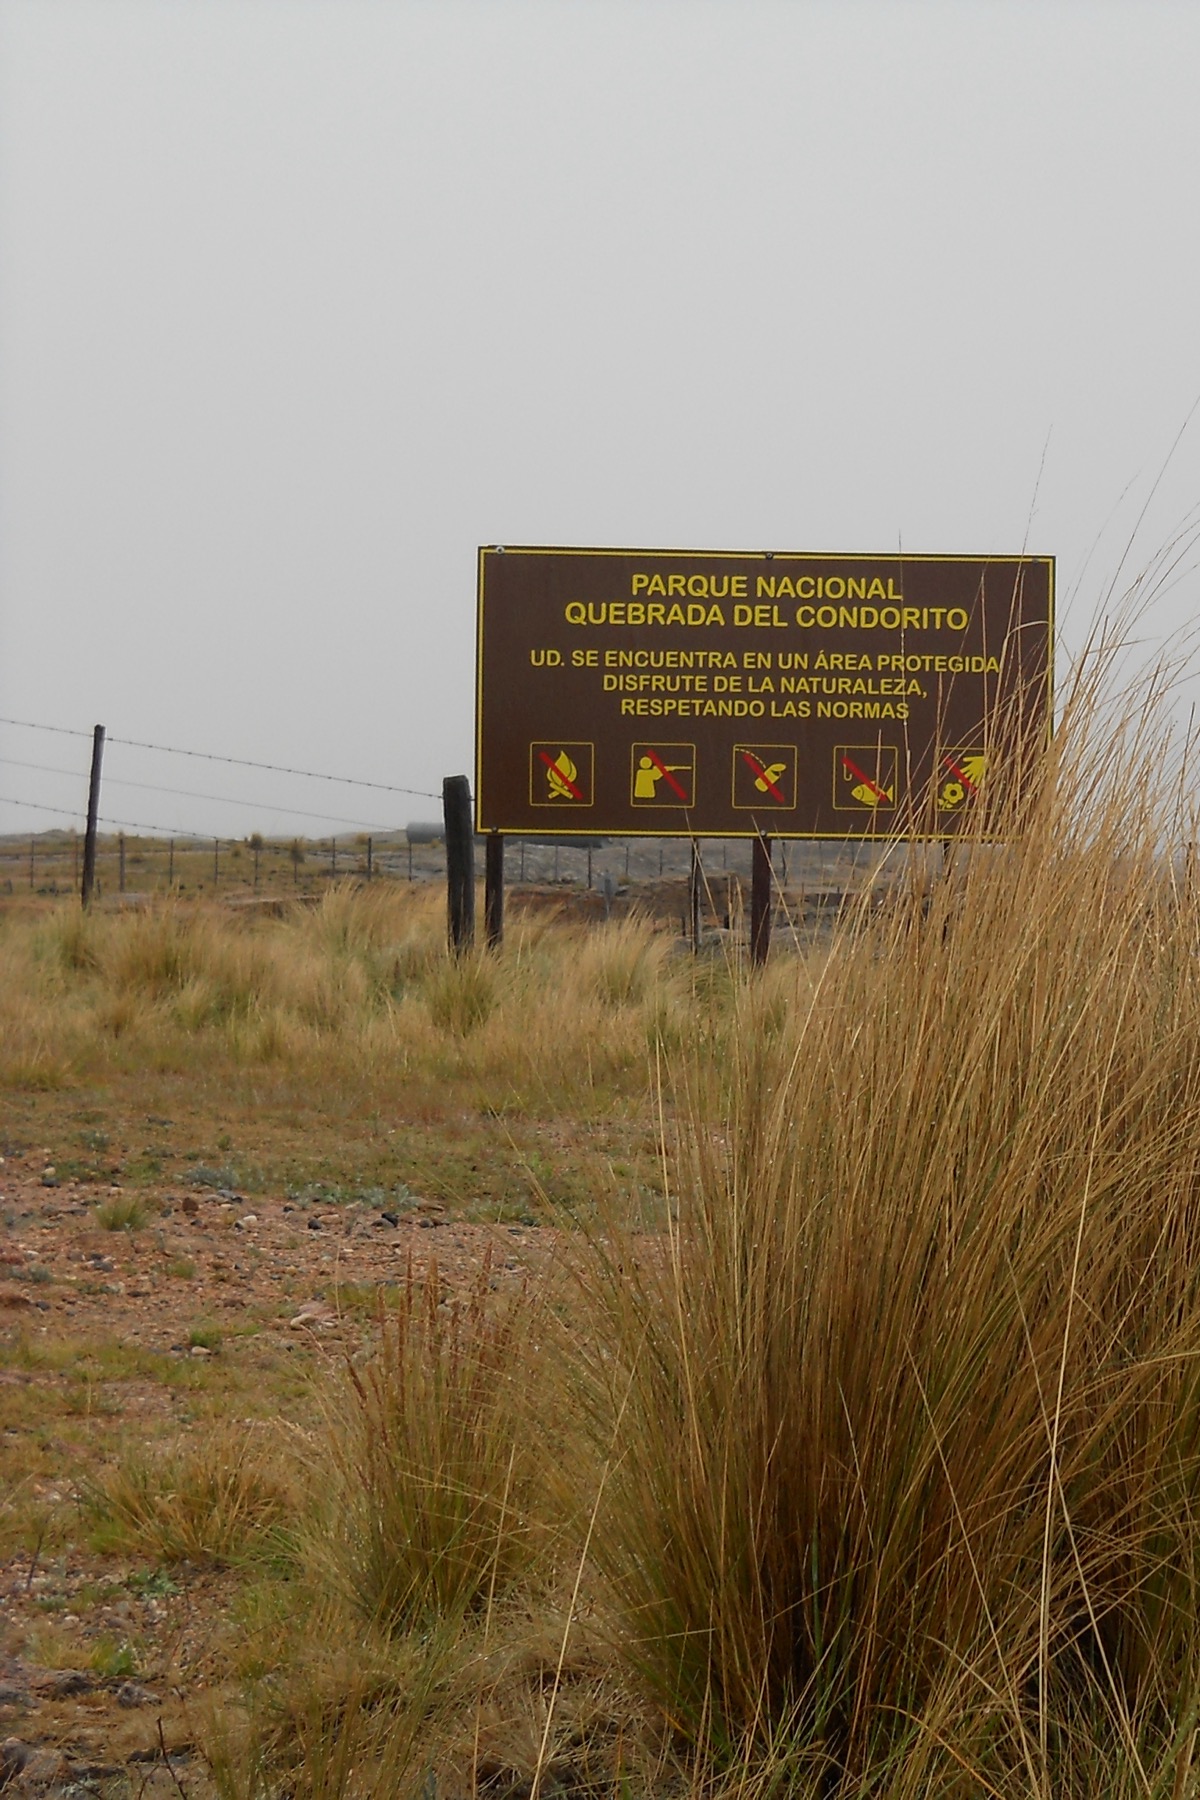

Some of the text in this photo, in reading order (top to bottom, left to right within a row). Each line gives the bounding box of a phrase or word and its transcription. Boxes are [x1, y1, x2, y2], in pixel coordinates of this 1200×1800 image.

[631, 574, 902, 600] PARQUE NACIONAL
[565, 601, 968, 630] QUEBRADA DEL CONDORITO
[530, 649, 1000, 673] UD. SE ENCUENTRA EN UN ÁREA PROTEGIDA
[604, 674, 927, 698] DISFRUTE DE LA NATURALEZA,
[620, 698, 909, 719] RESPETANDO LAS NORMAS
